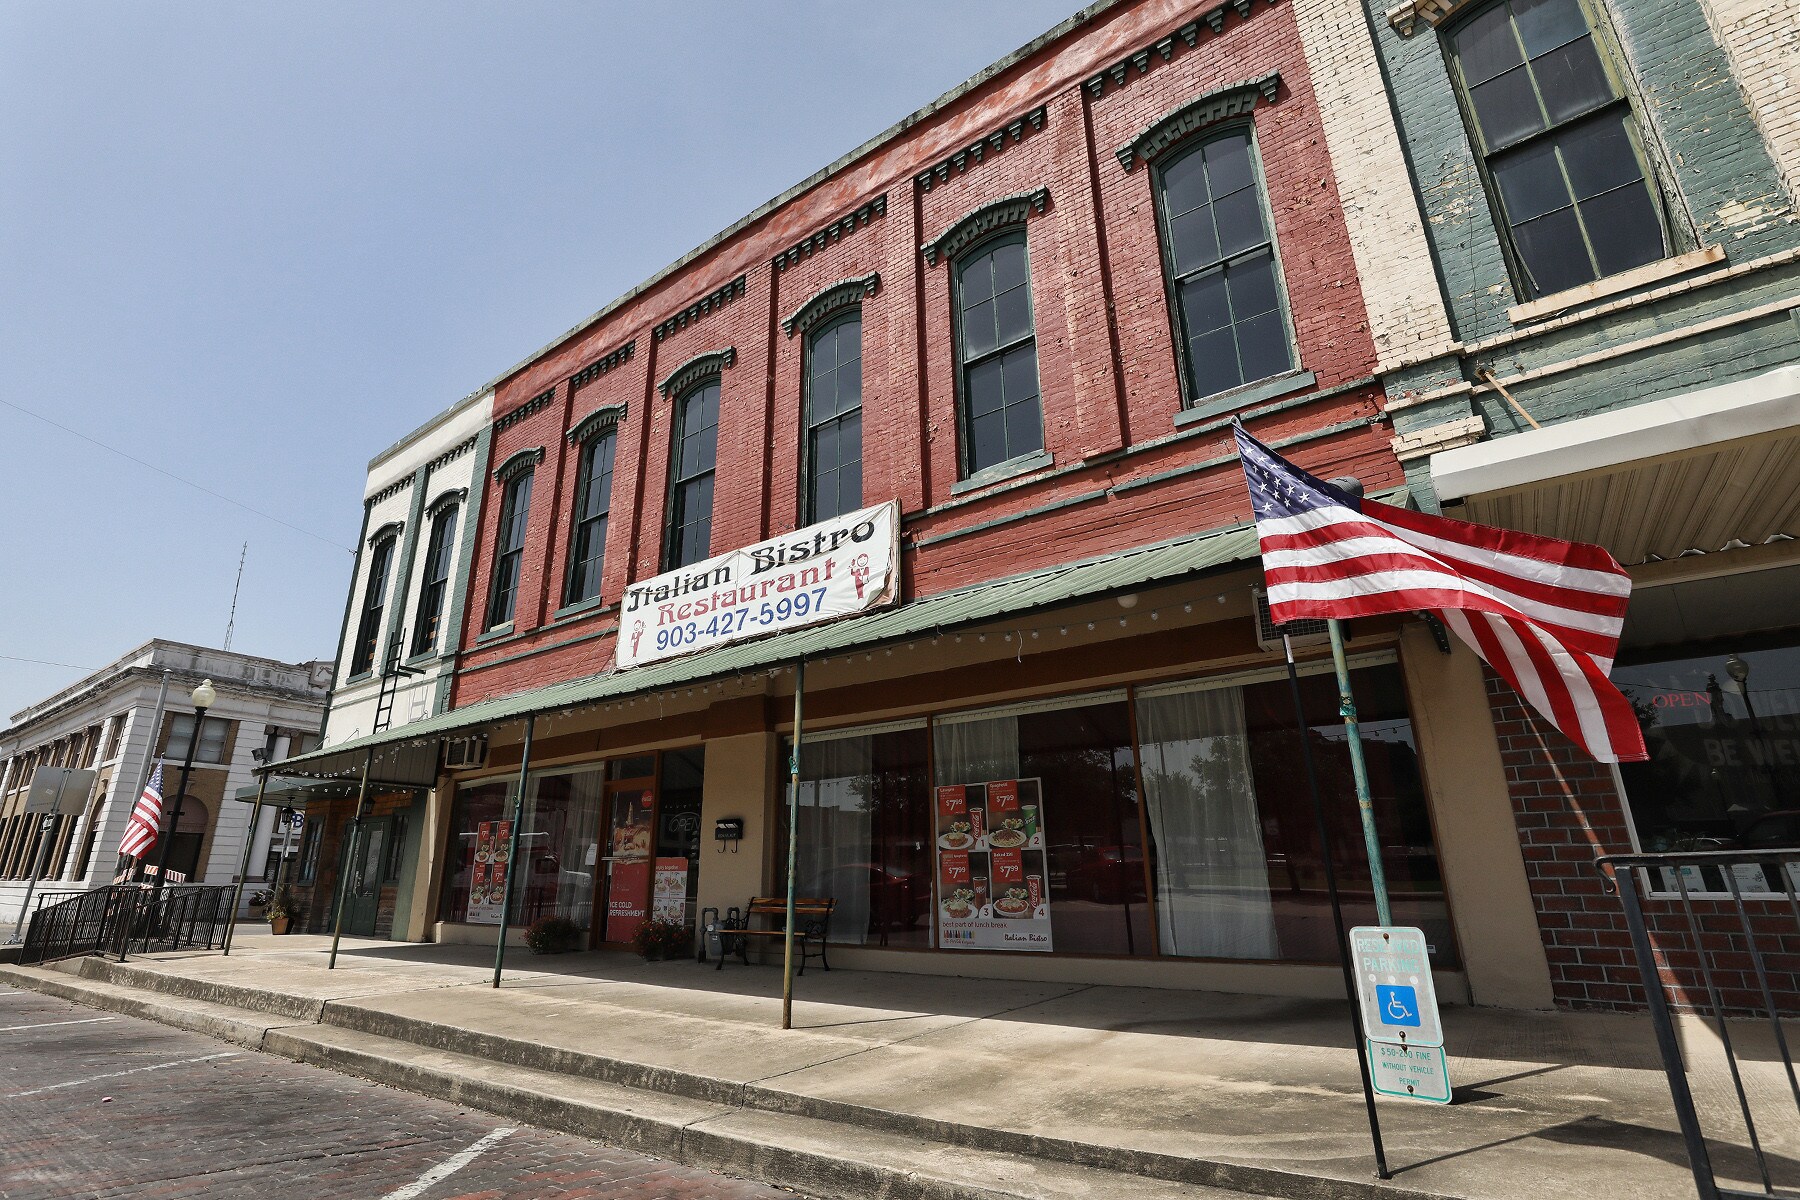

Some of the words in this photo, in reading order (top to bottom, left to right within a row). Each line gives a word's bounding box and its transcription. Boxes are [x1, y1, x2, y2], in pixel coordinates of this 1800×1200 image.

[627, 565, 731, 612] Italian
[750, 520, 875, 576] Bistro
[657, 557, 837, 627] Restaurant
[656, 587, 828, 651] 903-427-5997
[1652, 692, 1712, 708] OPEN
[1704, 739, 1743, 767] BE
[980, 839, 985, 847] 1
[1033, 836, 1040, 845] 2
[618, 901, 633, 909] COLD
[609, 909, 645, 917] REFRESHMENT
[983, 908, 989, 917] 3
[1038, 908, 1045, 917] 4
[1004, 933, 1027, 942] Italian
[1028, 933, 1048, 942] Bistro
[1362, 957, 1420, 974] PARKING
[1415, 1051, 1431, 1061] FINE
[1382, 1061, 1407, 1072] WITHOUT
[1408, 1065, 1434, 1075] VEHICLE
[1398, 1077, 1420, 1087] PERMIT
